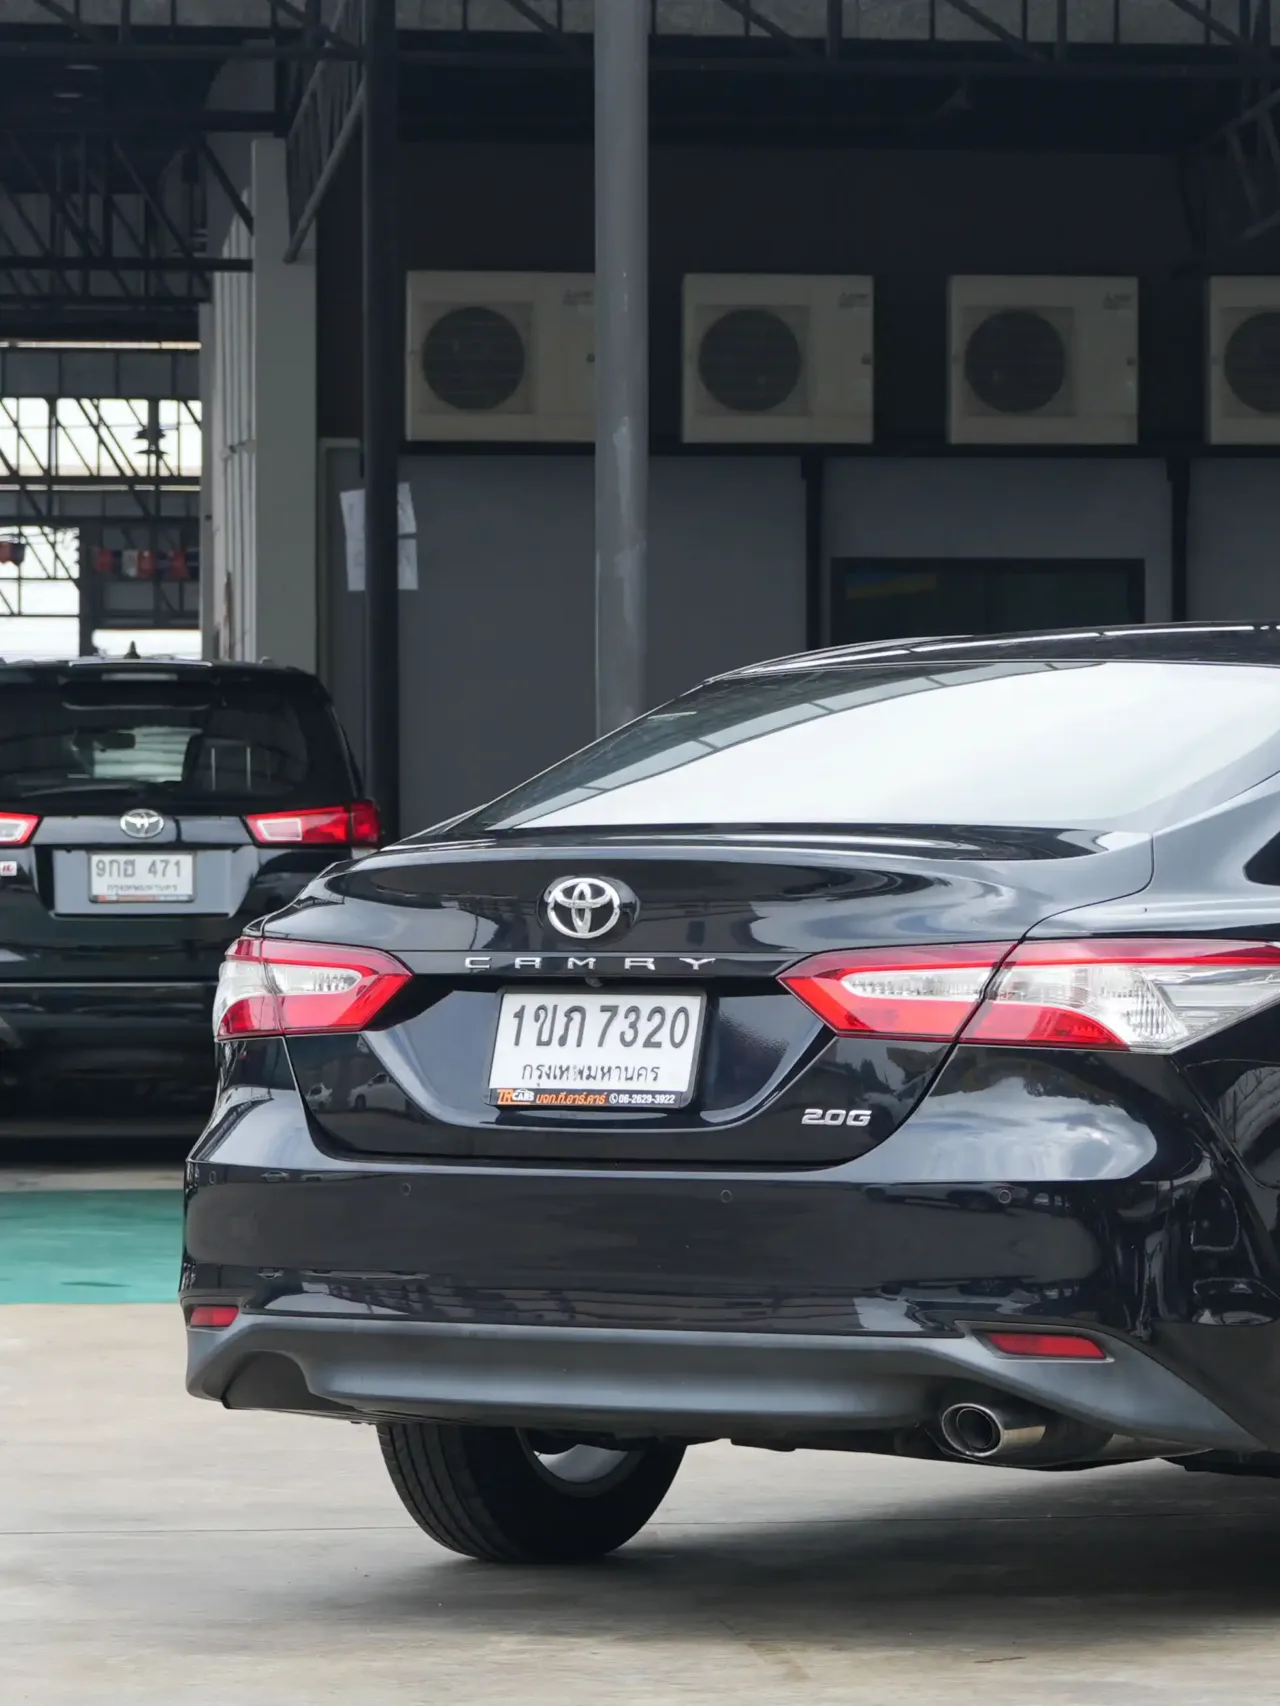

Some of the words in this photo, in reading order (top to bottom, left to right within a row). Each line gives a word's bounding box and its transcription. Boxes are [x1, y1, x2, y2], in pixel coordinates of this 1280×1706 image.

[148, 859, 181, 878] 471
[464, 956, 716, 971] CAMRY
[513, 1004, 587, 1047] 1ขภ
[597, 1004, 690, 1049] 7320
[521, 1063, 661, 1088] กรุงเทพมหานคร
